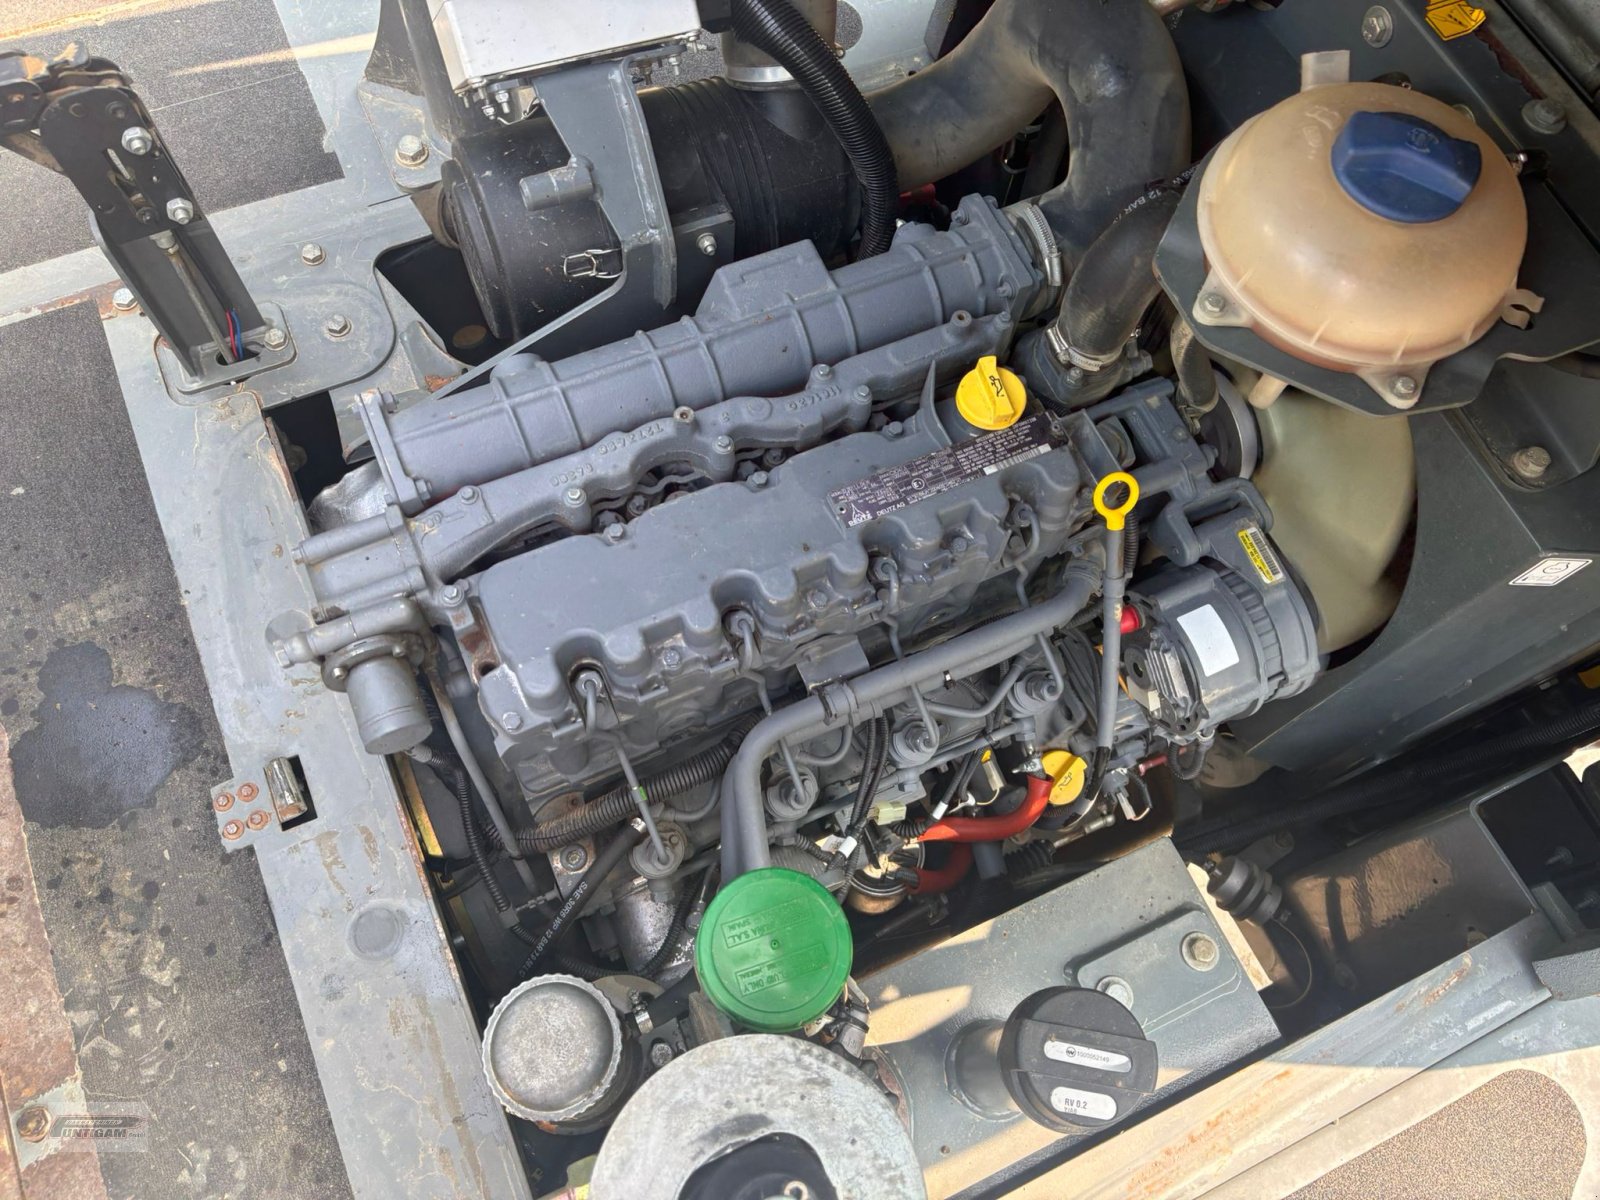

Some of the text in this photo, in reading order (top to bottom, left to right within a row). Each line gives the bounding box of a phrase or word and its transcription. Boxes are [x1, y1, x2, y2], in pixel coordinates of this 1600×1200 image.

[1149, 189, 1162, 200] 12
[1124, 196, 1147, 215] BAR
[877, 501, 906, 517] DEUTZ AG
[573, 881, 587, 899] SAE
[552, 916, 563, 931] WP
[545, 928, 553, 939] 12
[536, 935, 549, 952] BAR
[1064, 1098, 1088, 1110] RV 0.2
